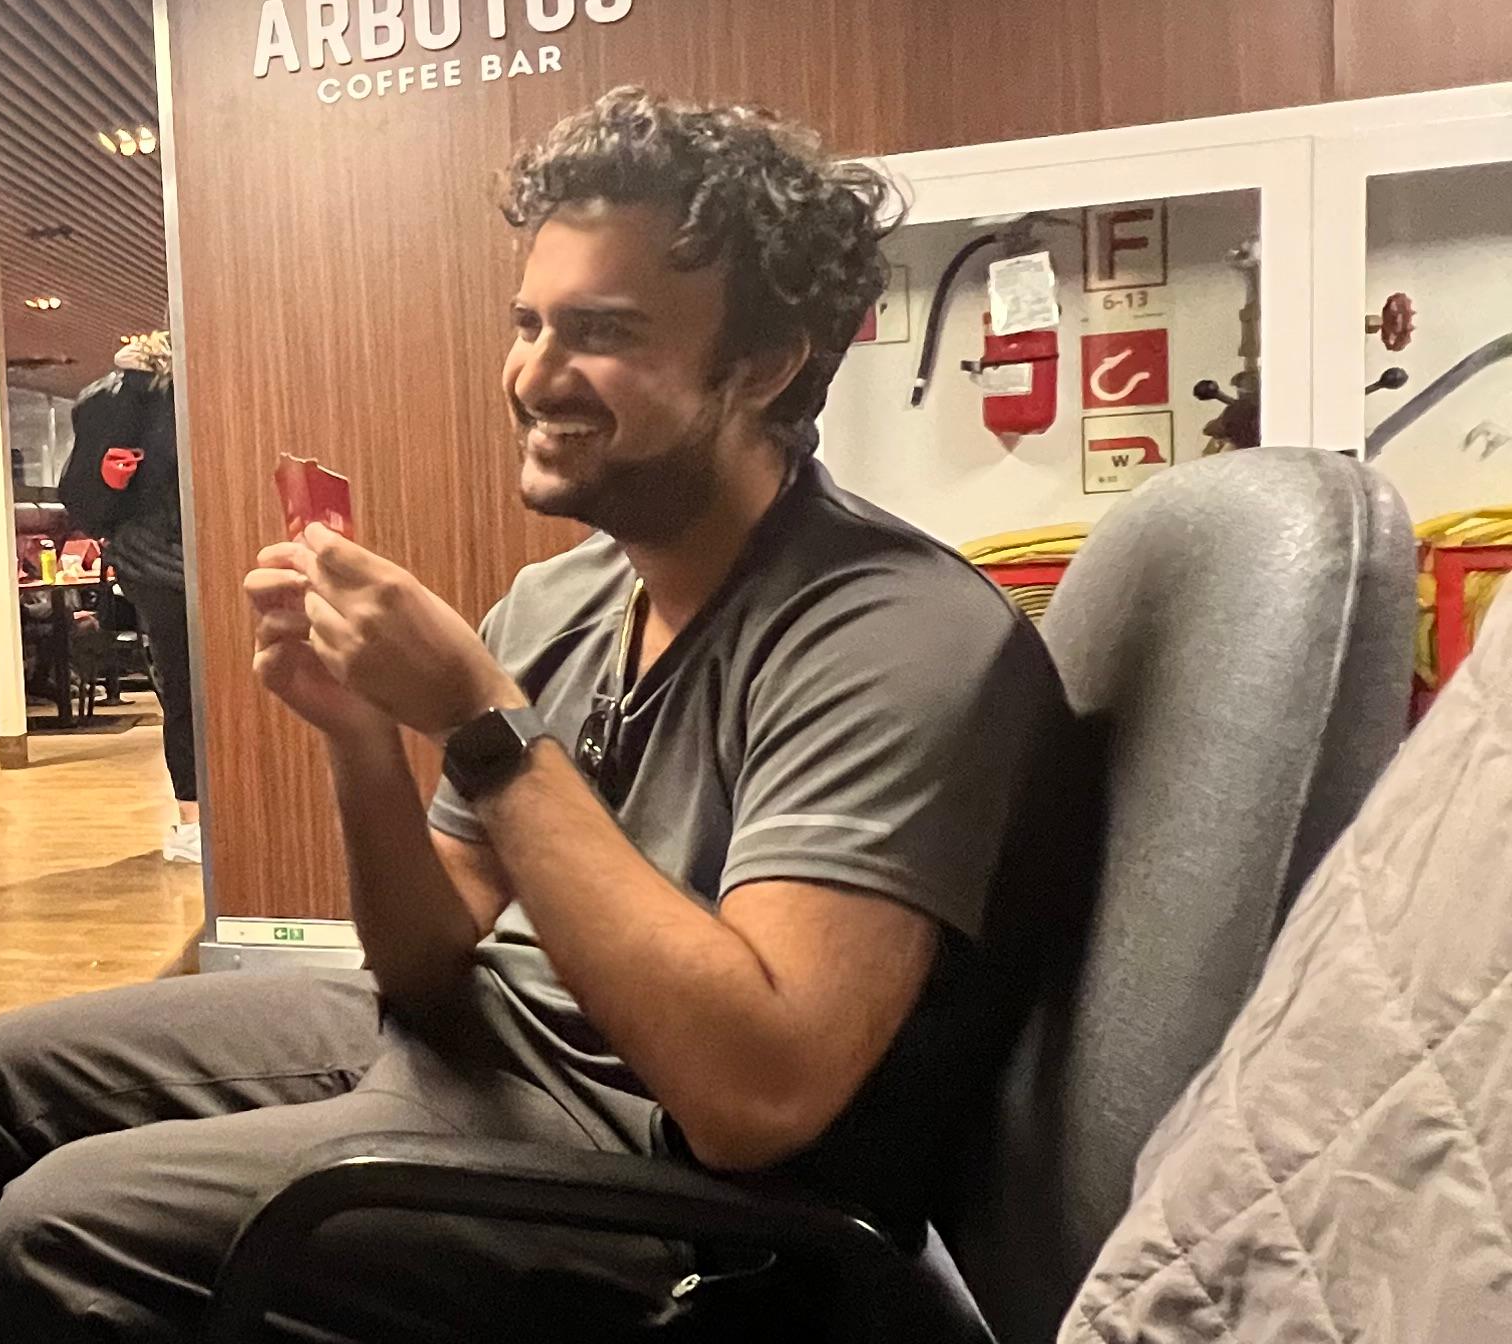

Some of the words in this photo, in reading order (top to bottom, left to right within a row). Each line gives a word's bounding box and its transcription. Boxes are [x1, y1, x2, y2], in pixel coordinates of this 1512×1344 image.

[317, 52, 463, 104] COFFEE
[480, 45, 563, 83] BAR
[1097, 208, 1154, 281] F
[1102, 290, 1149, 311] 6-13
[1111, 454, 1130, 468] W
